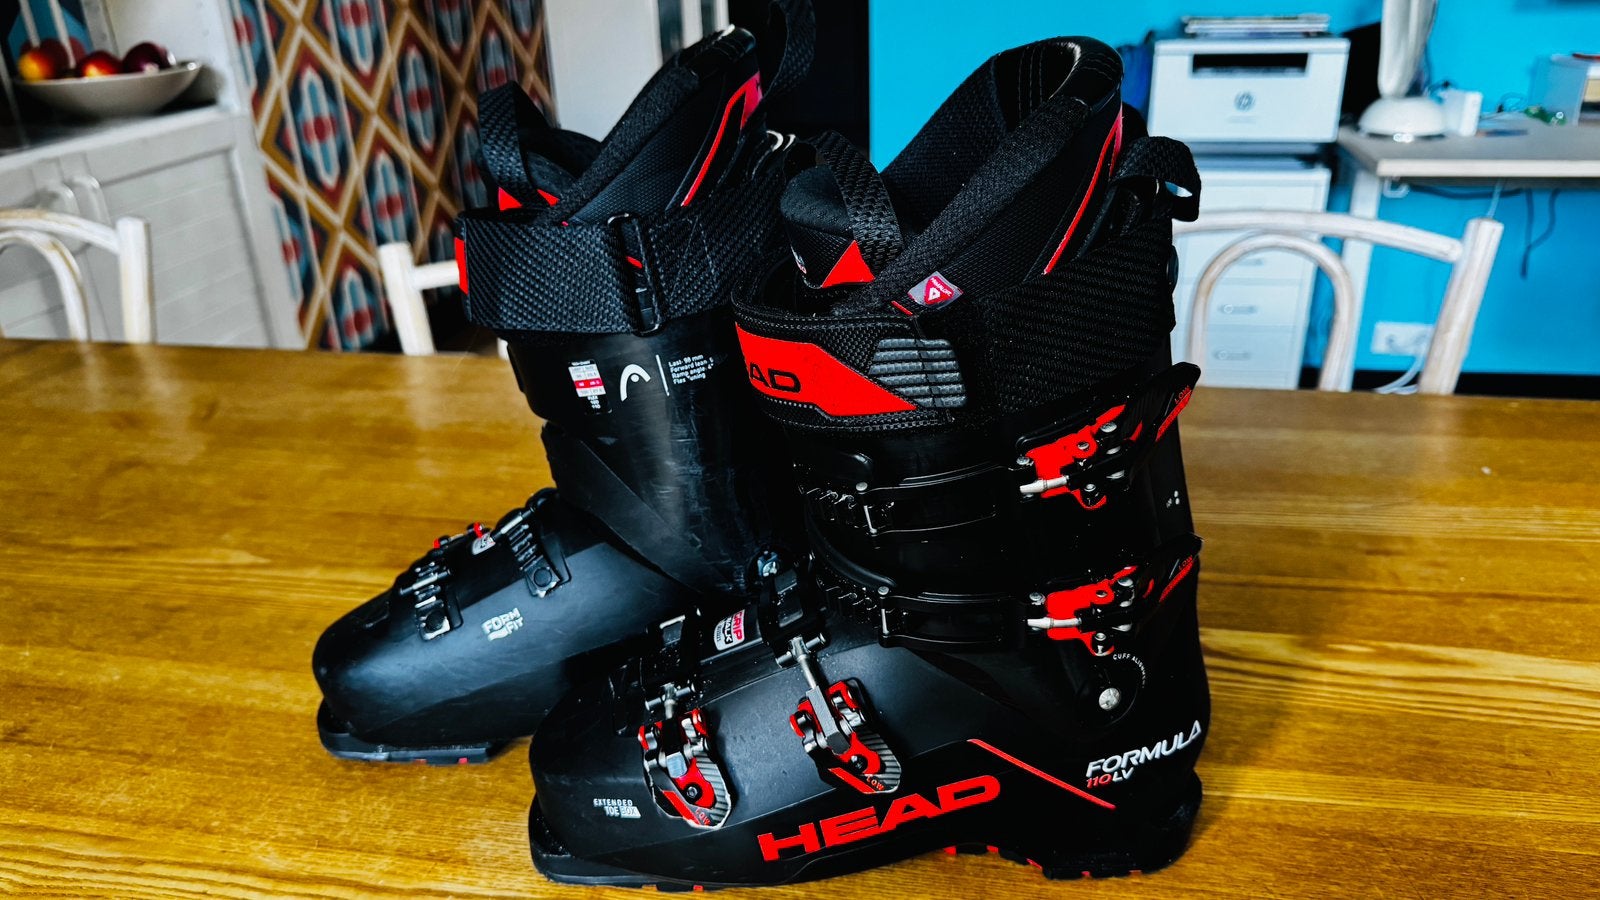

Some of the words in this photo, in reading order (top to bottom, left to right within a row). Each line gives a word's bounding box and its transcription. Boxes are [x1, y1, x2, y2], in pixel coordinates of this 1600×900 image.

[670, 362, 694, 373] Forward
[481, 607, 521, 635] FORM
[505, 616, 524, 635] FIT
[1112, 652, 1131, 660] CUFF
[1086, 719, 1202, 778] FORMULA
[865, 775, 885, 791] LOW
[592, 798, 634, 807] EXTENDED
[604, 806, 621, 817] TOE
[621, 806, 640, 818] BOX
[757, 774, 1001, 862] HEAD
